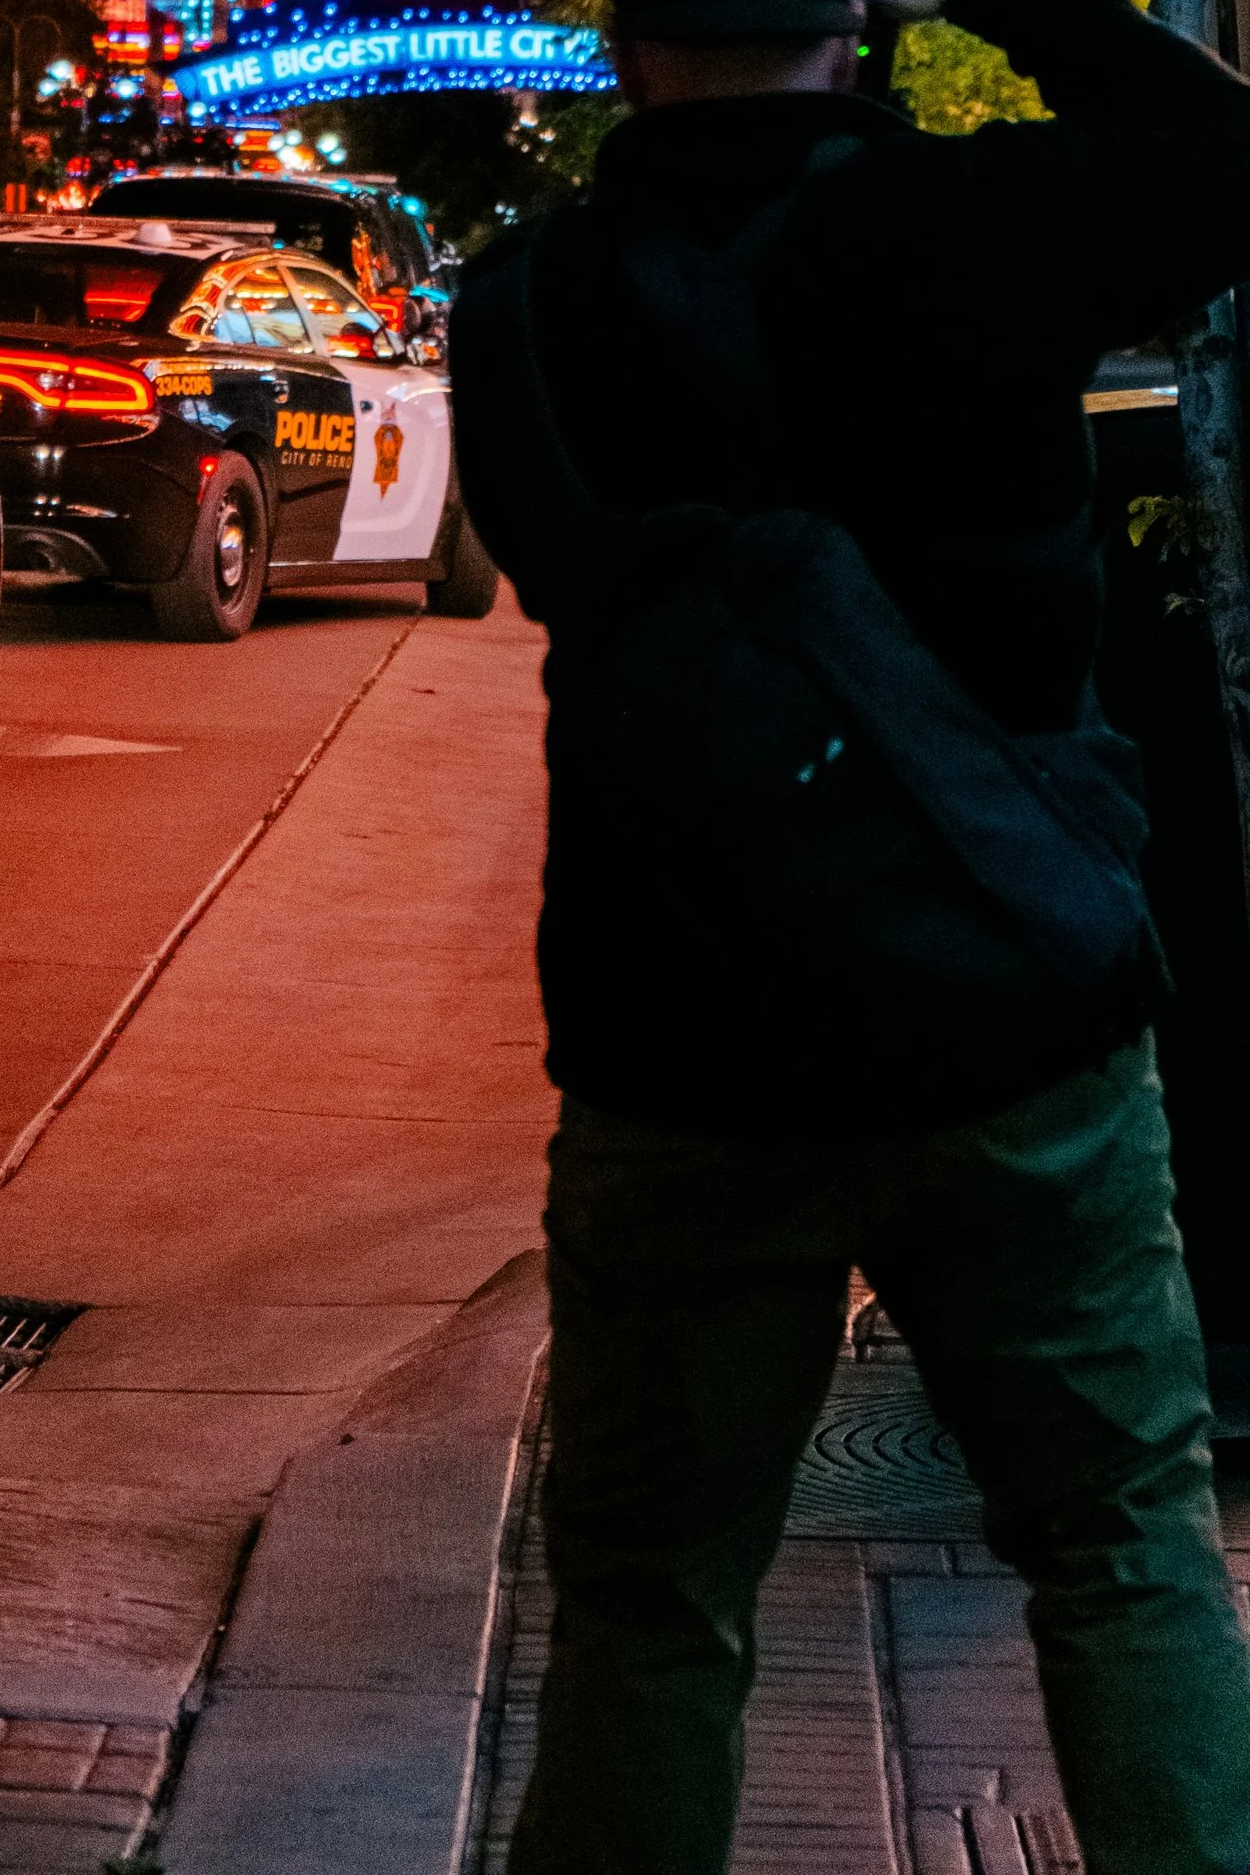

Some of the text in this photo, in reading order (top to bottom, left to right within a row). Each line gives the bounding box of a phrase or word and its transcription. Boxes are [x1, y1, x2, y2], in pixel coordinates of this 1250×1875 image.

[201, 57, 263, 96] THE
[271, 33, 401, 80] BIGGEST
[409, 28, 503, 63] LITTLE
[155, 376, 214, 397] 334-COPS
[274, 410, 355, 452] POLICE
[281, 452, 353, 468] CITY OF RENO
